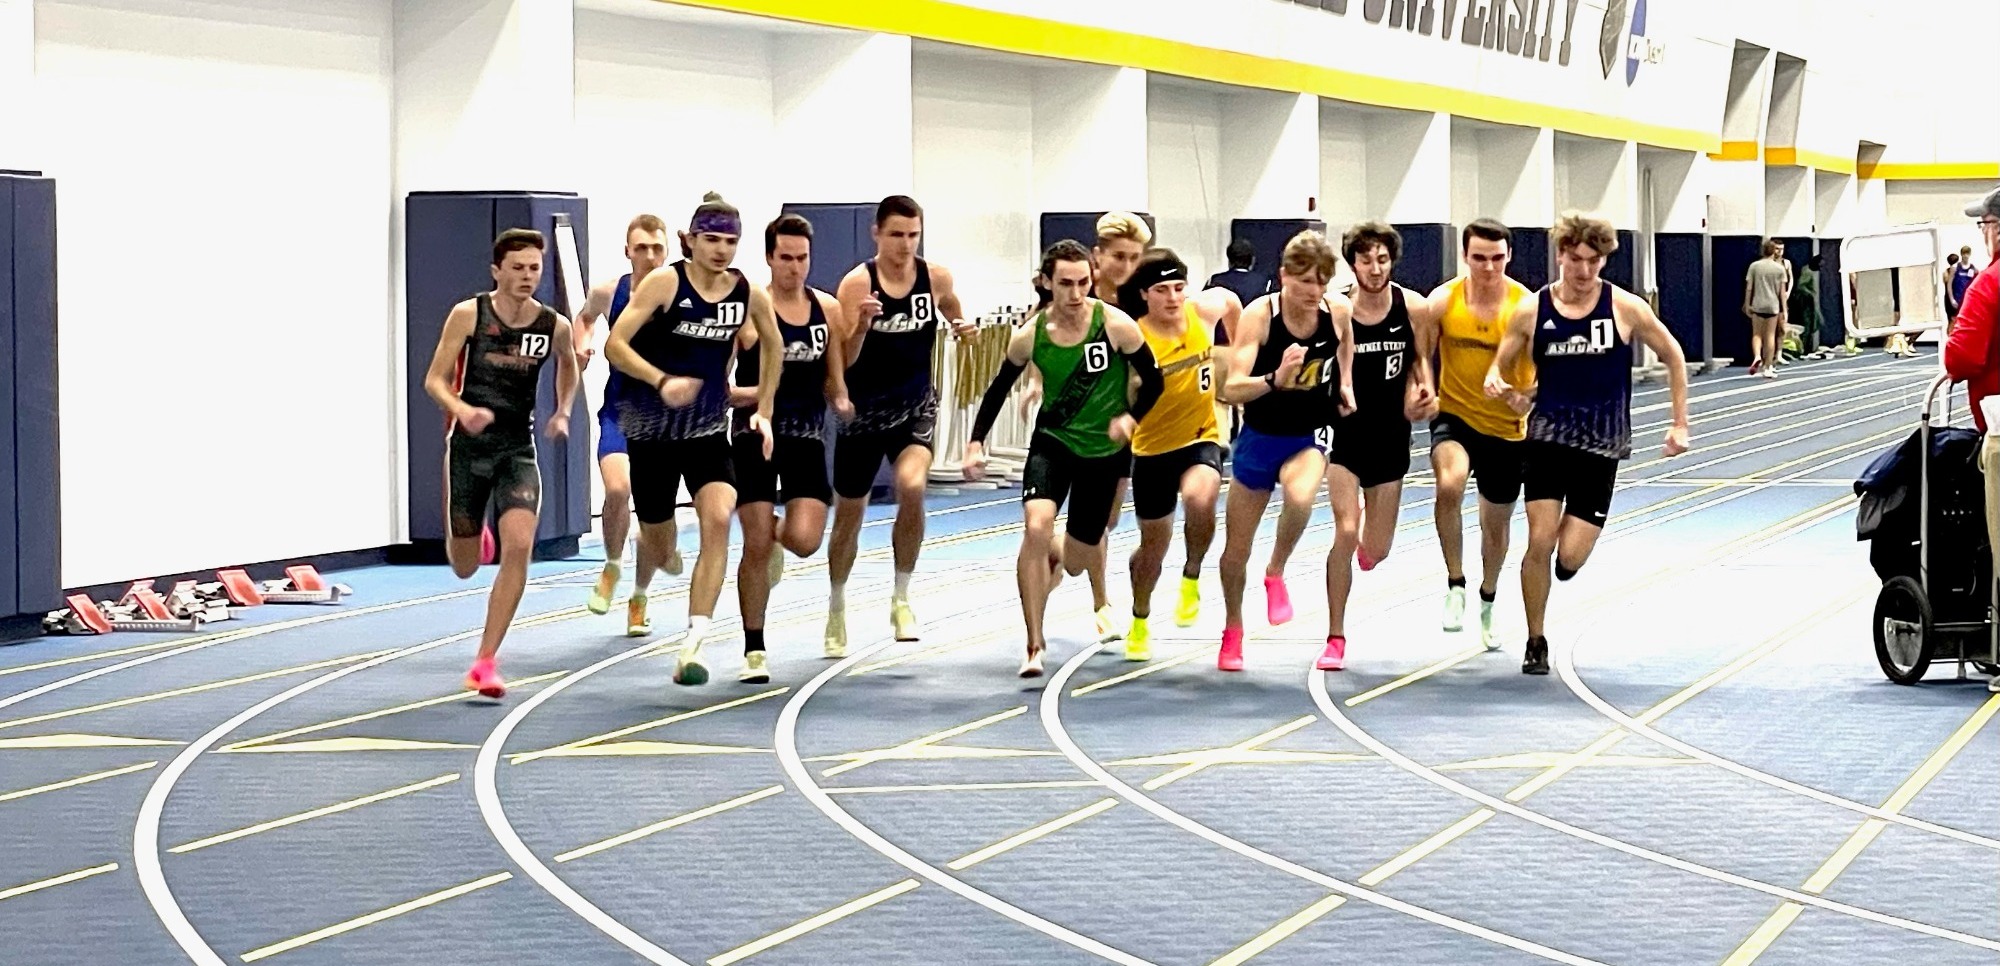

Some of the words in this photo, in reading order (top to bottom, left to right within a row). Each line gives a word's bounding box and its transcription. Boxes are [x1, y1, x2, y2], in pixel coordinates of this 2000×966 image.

[719, 303, 737, 325] 11
[914, 296, 929, 321] 8
[525, 335, 546, 356] 12
[814, 327, 827, 352] 9
[1594, 321, 1606, 346] 1
[1088, 344, 1106, 370] 6
[1388, 354, 1401, 377] 3
[1201, 367, 1211, 391] 5
[1318, 426, 1329, 446] 4
